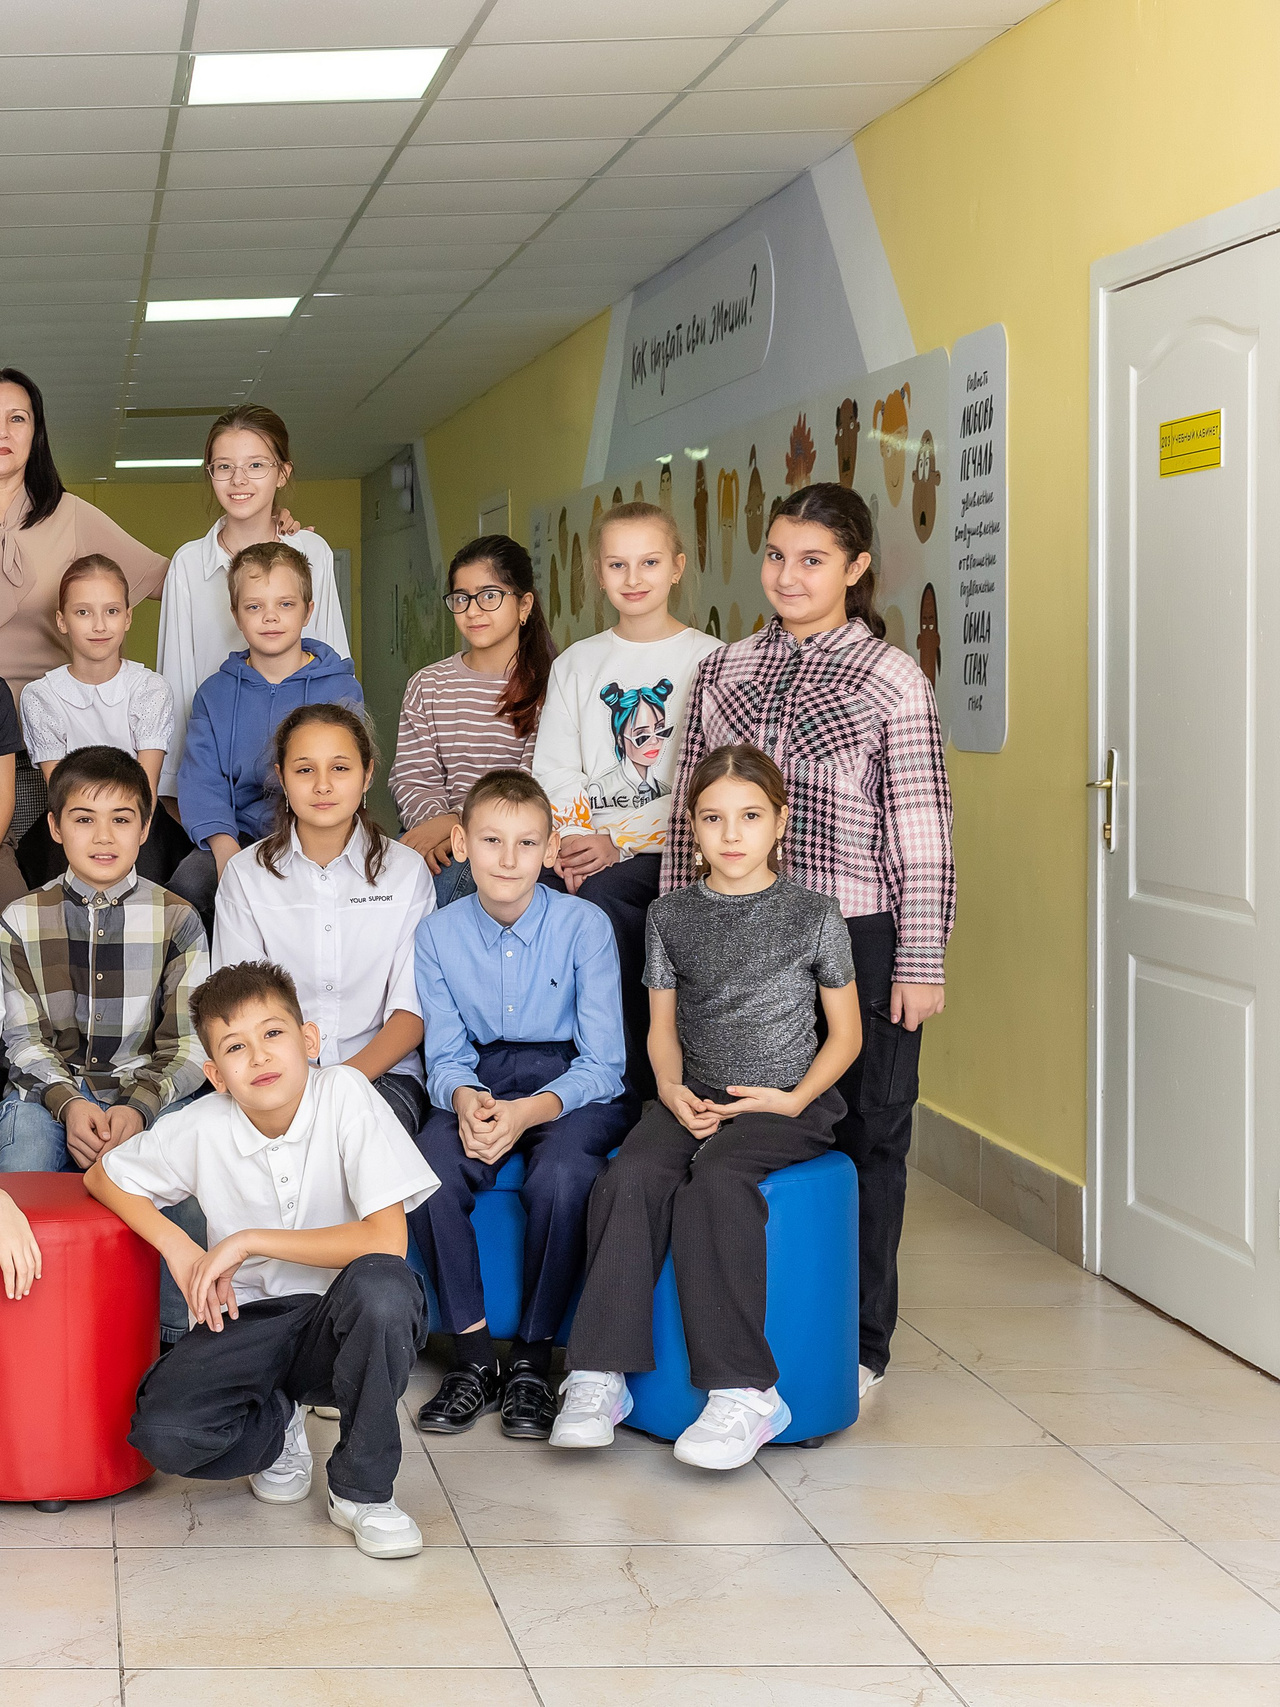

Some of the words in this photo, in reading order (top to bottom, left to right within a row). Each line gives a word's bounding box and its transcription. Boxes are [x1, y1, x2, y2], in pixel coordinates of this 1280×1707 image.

[959, 393, 994, 440] ЛЮБОВЬ
[959, 439, 994, 482] ПЕЧАЛЬ
[963, 609, 991, 645] ОБИДА
[963, 652, 989, 687] СТРАХ
[589, 795, 630, 810] ILLIE
